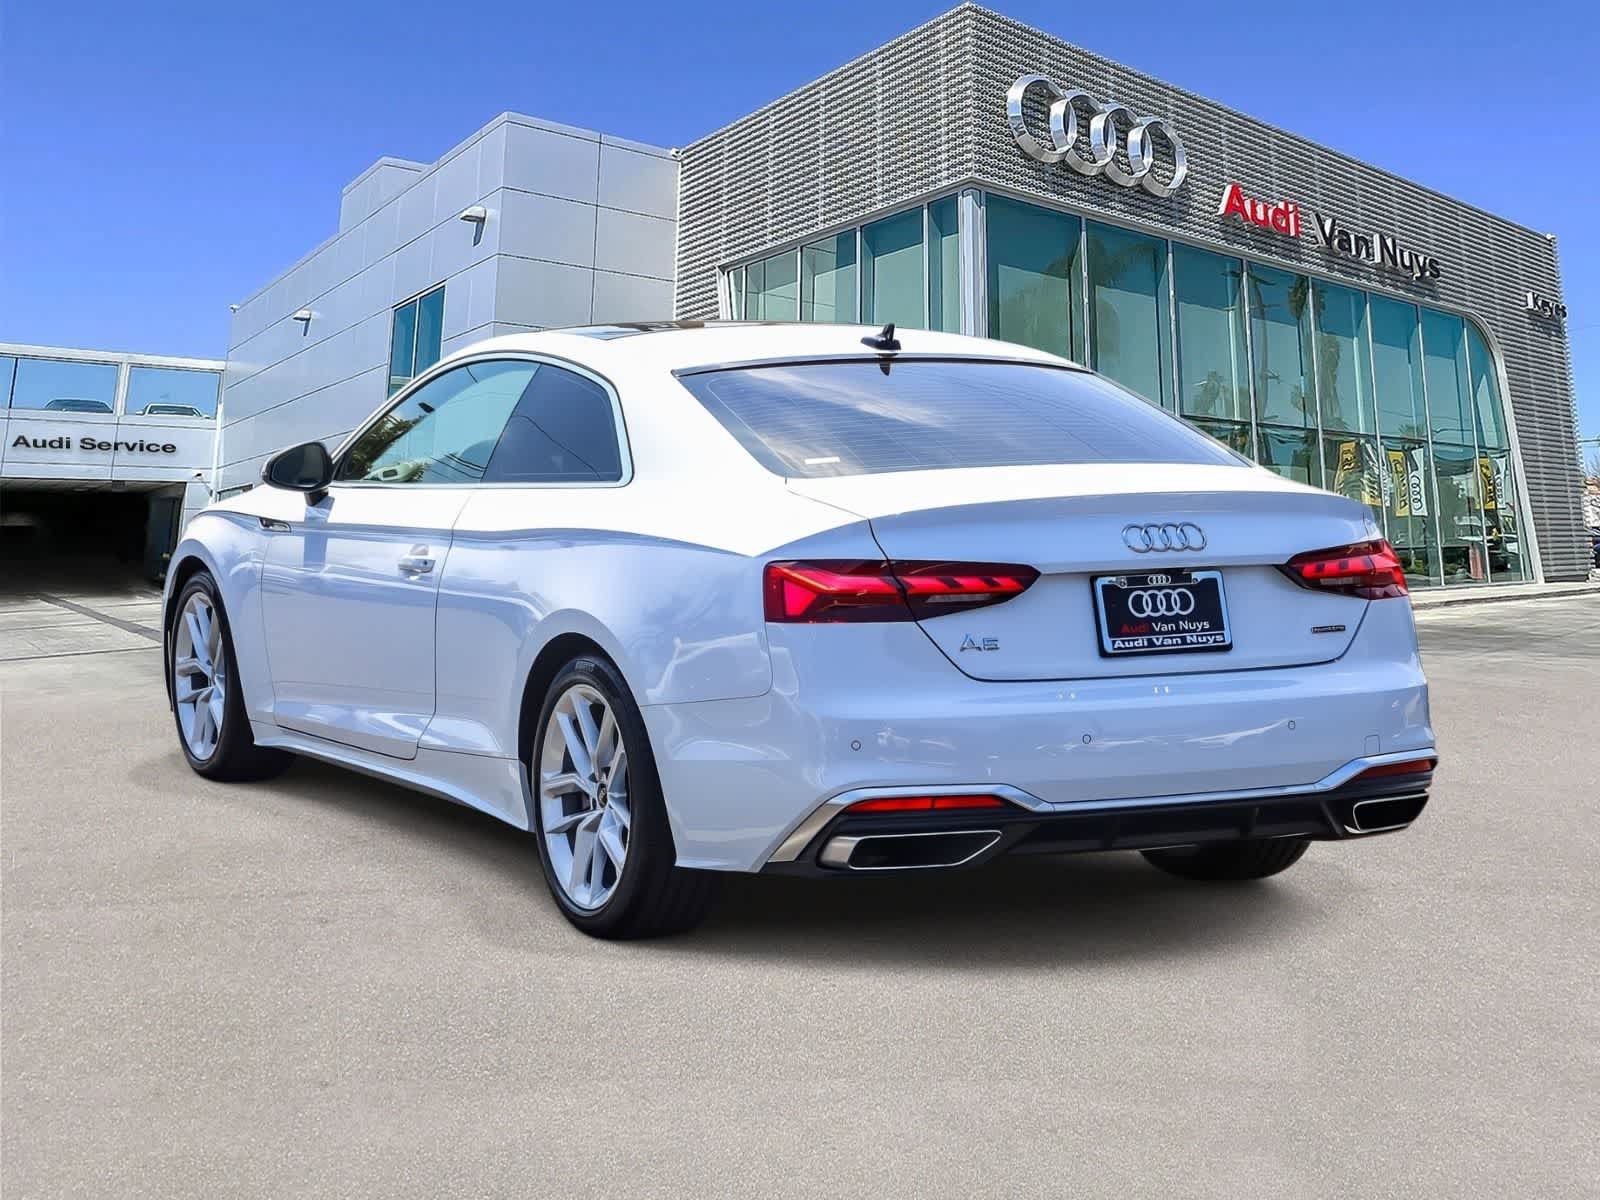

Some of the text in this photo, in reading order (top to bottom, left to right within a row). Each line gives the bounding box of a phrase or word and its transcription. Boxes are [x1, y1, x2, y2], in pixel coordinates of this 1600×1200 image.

[1217, 182, 1441, 281] Audi Van Nuys
[12, 435, 177, 454] Audi Service
[1120, 620, 1210, 634] Audi Van Nuys
[1113, 633, 1225, 649] Audi Van Nuys
